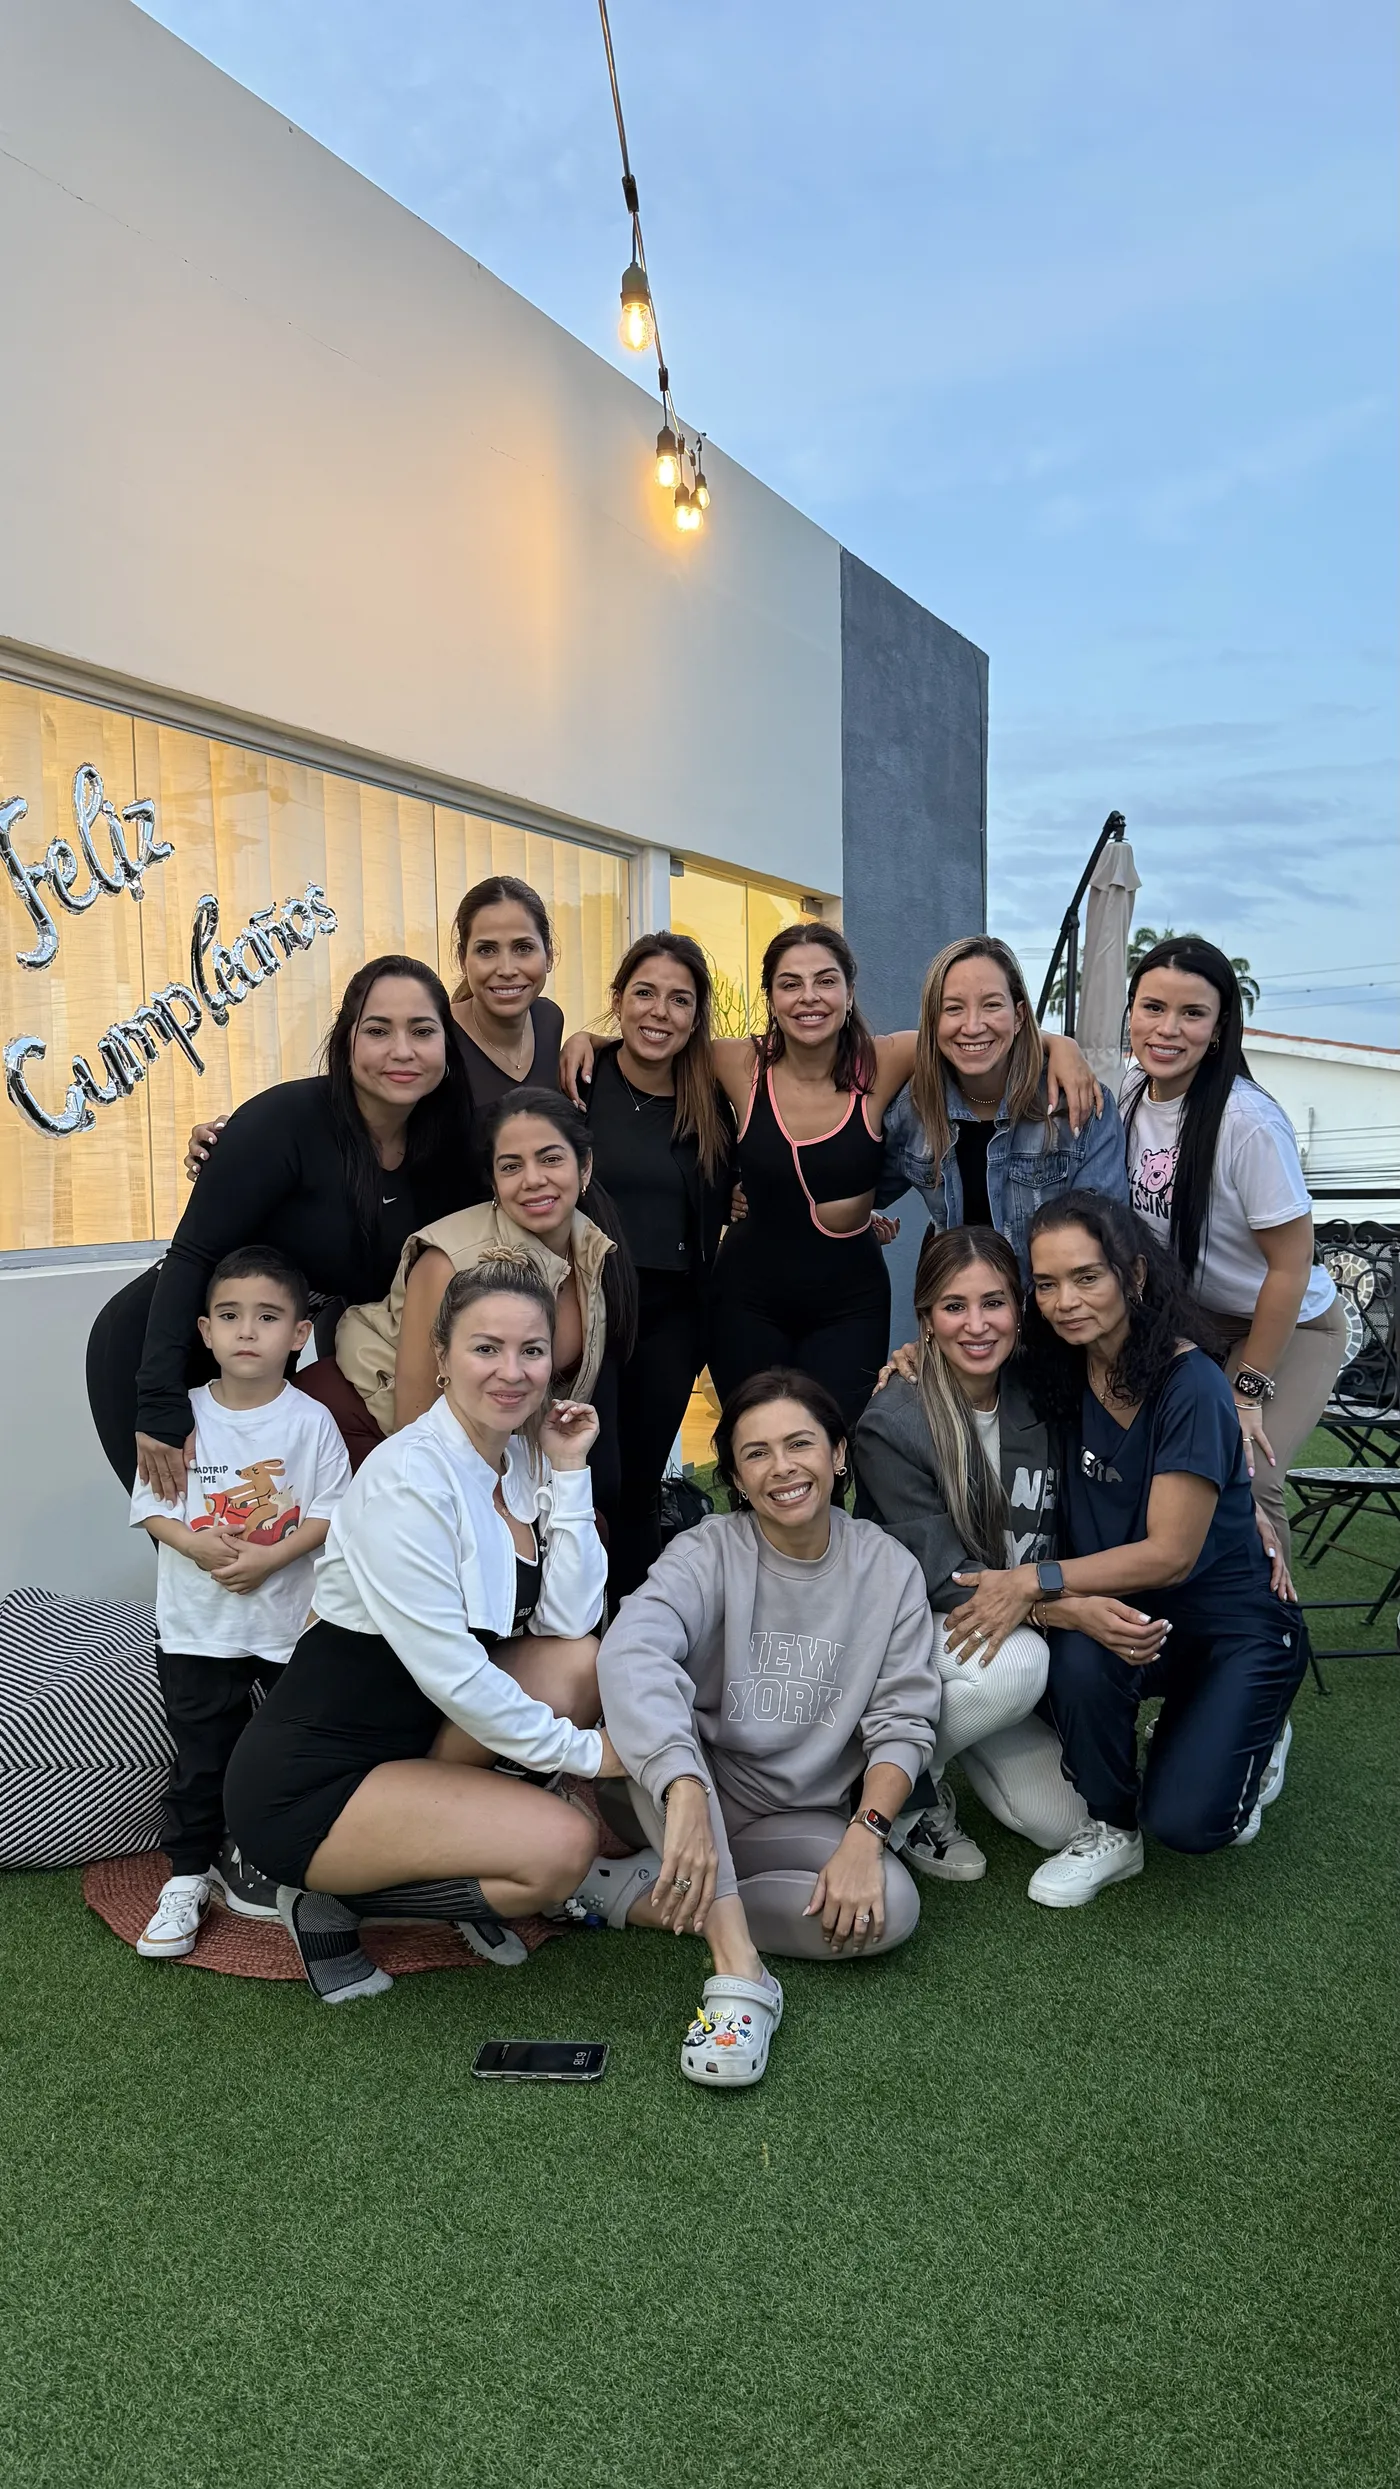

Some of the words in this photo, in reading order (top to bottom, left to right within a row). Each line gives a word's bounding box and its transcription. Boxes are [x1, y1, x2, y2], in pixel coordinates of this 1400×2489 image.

[0, 761, 176, 972] Feliz
[3, 880, 339, 1140] Cumpleaños
[193, 1465, 229, 1475] ADTRIP
[743, 1631, 846, 1685] NEW
[727, 1678, 843, 1729] YORK
